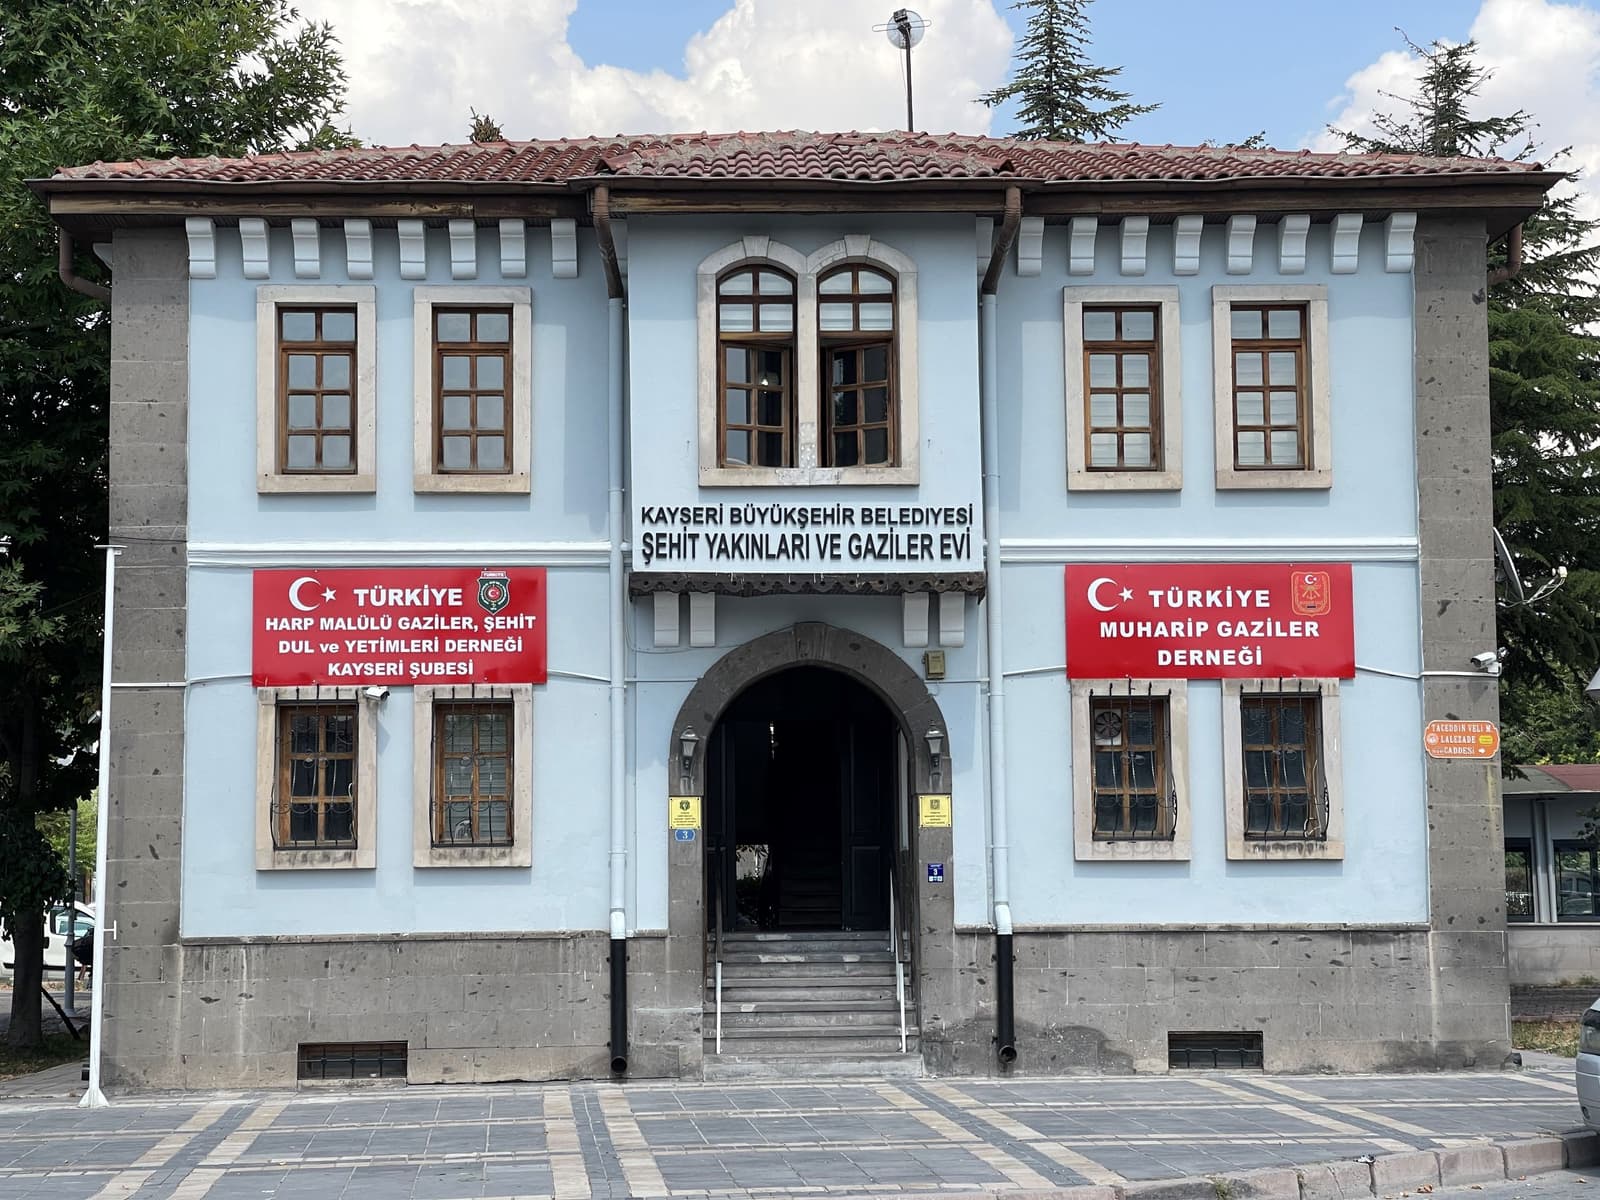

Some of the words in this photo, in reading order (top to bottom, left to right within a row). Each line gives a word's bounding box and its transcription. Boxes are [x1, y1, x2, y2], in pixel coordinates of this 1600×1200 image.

[641, 503, 723, 524] KAYSERİ
[730, 503, 855, 528] BÜYÜKŞEHİR
[642, 527, 699, 564] ŞEHİT
[705, 533, 809, 559] YAKINLARI
[816, 533, 842, 559] VE
[849, 527, 934, 559] GAZİLER
[942, 527, 971, 559] EVİ
[353, 585, 463, 606] TÜRKİYE
[1148, 586, 1271, 608] TÜRKİYE
[265, 618, 314, 631] HARP
[319, 615, 392, 631] MALÜLÜ
[398, 614, 479, 632] GAZİLER,
[483, 613, 536, 633] ŞEHİT
[1100, 617, 1209, 638] MUHARİP
[1217, 617, 1320, 638] GAZİLER
[278, 640, 315, 654] DUL
[319, 642, 340, 654] ve
[344, 637, 439, 653] YETİMLERİ
[445, 636, 523, 653] DERNEĞİ
[1157, 646, 1263, 666] DERNEĞİ
[328, 660, 404, 676] KAYSERİ
[408, 659, 474, 679] ŞUBESİ
[682, 831, 688, 839] 3
